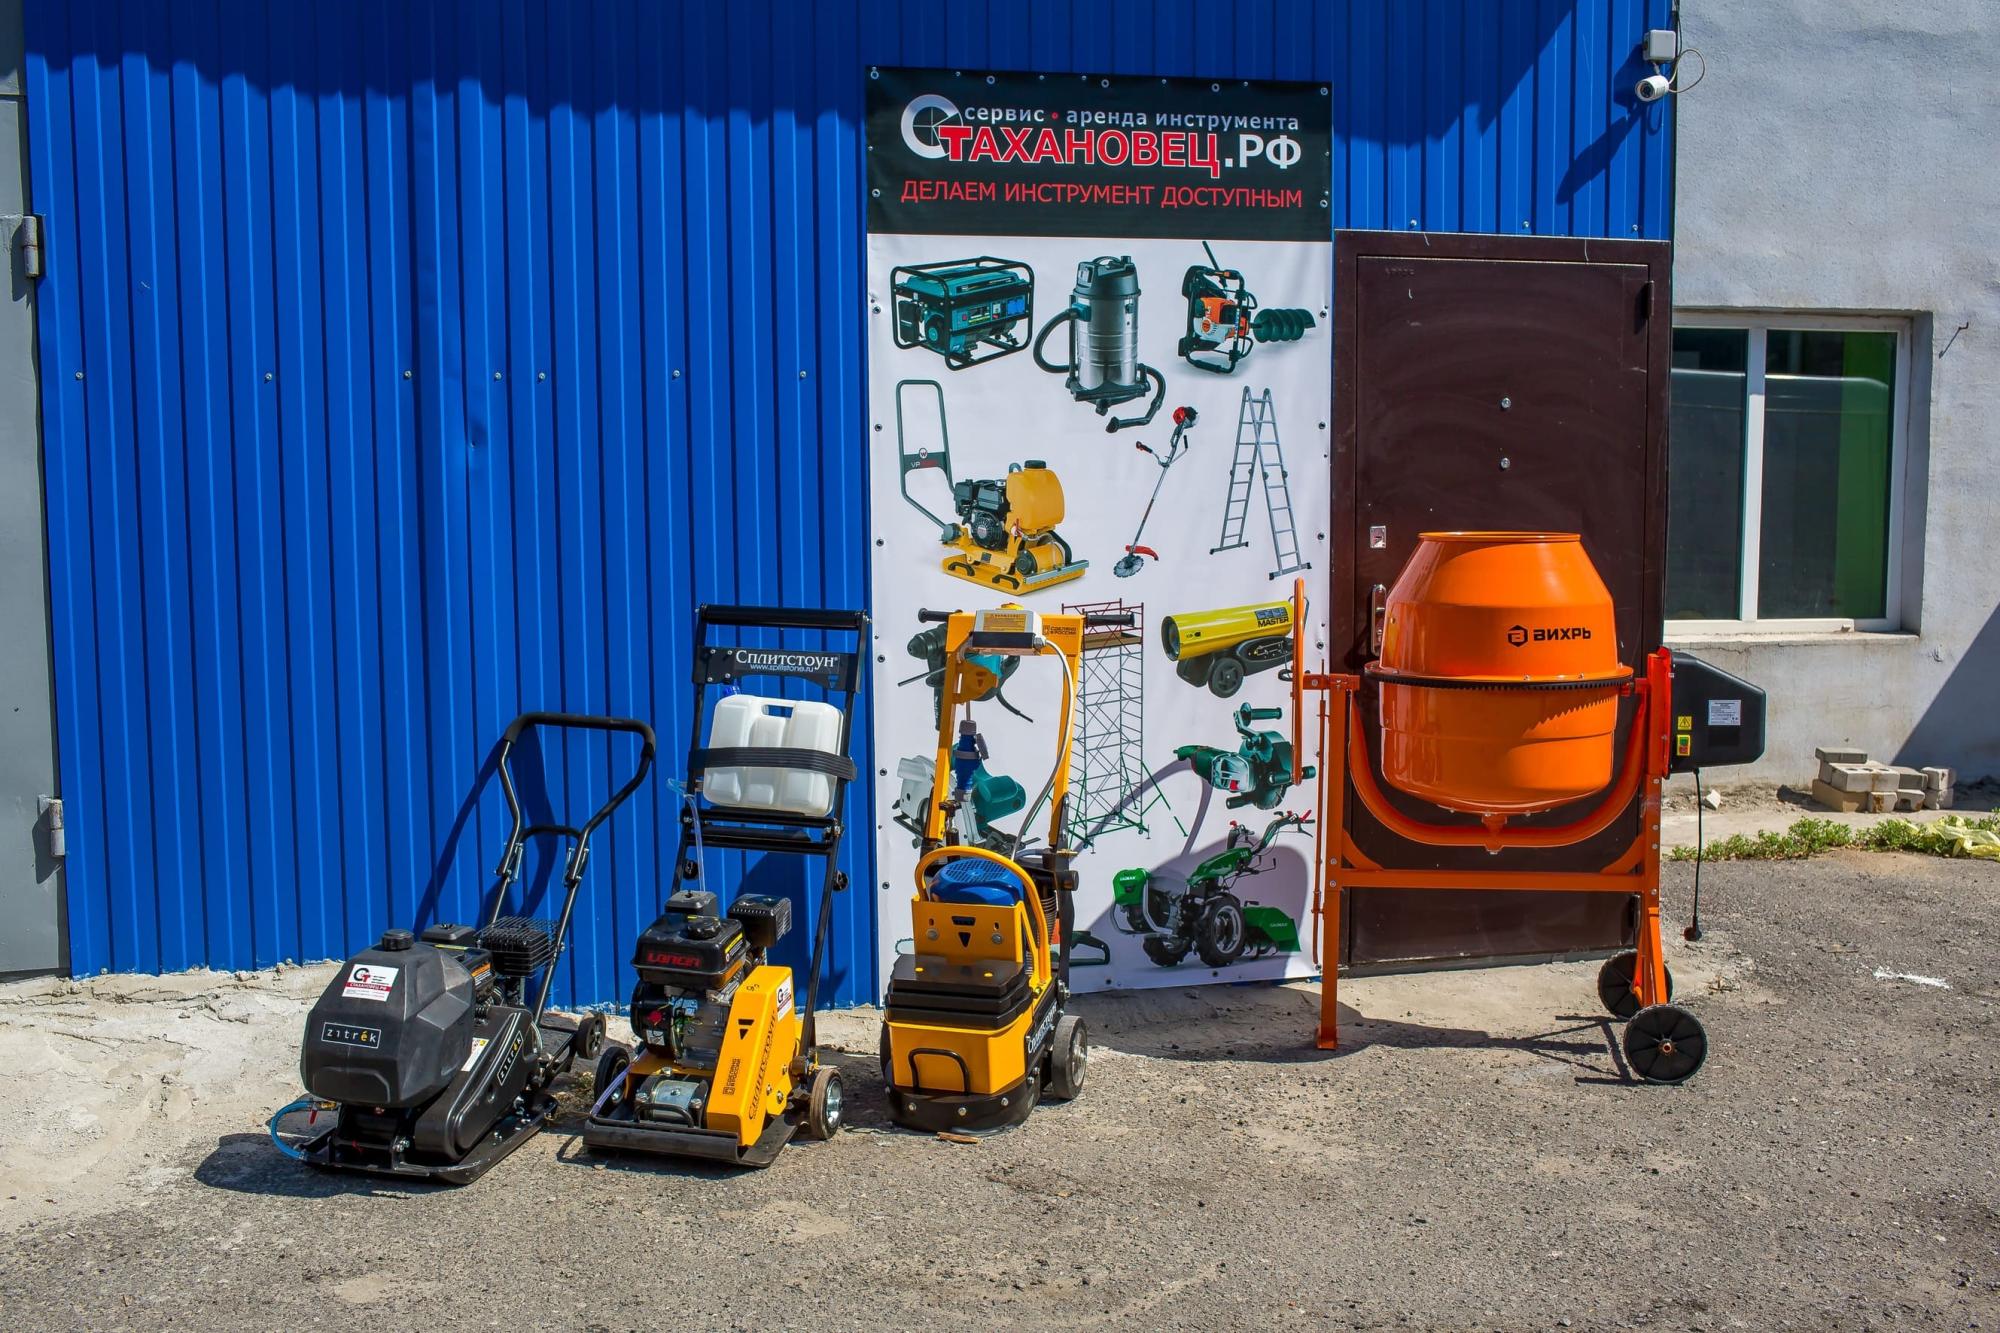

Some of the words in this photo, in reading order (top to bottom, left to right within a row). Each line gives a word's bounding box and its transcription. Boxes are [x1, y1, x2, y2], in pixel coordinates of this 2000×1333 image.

[965, 107, 1045, 124] сервис
[1067, 110, 1147, 127] аренда
[1156, 113, 1299, 132] инструмента
[901, 181, 996, 204] ДЕЛАЕМ
[1005, 182, 1155, 205] ИНСТРУМЕНТ
[1161, 187, 1302, 209] ДОСТУПНЫМ
[1258, 617, 1289, 628] MASTER
[1533, 627, 1592, 641] ВИХРЬ
